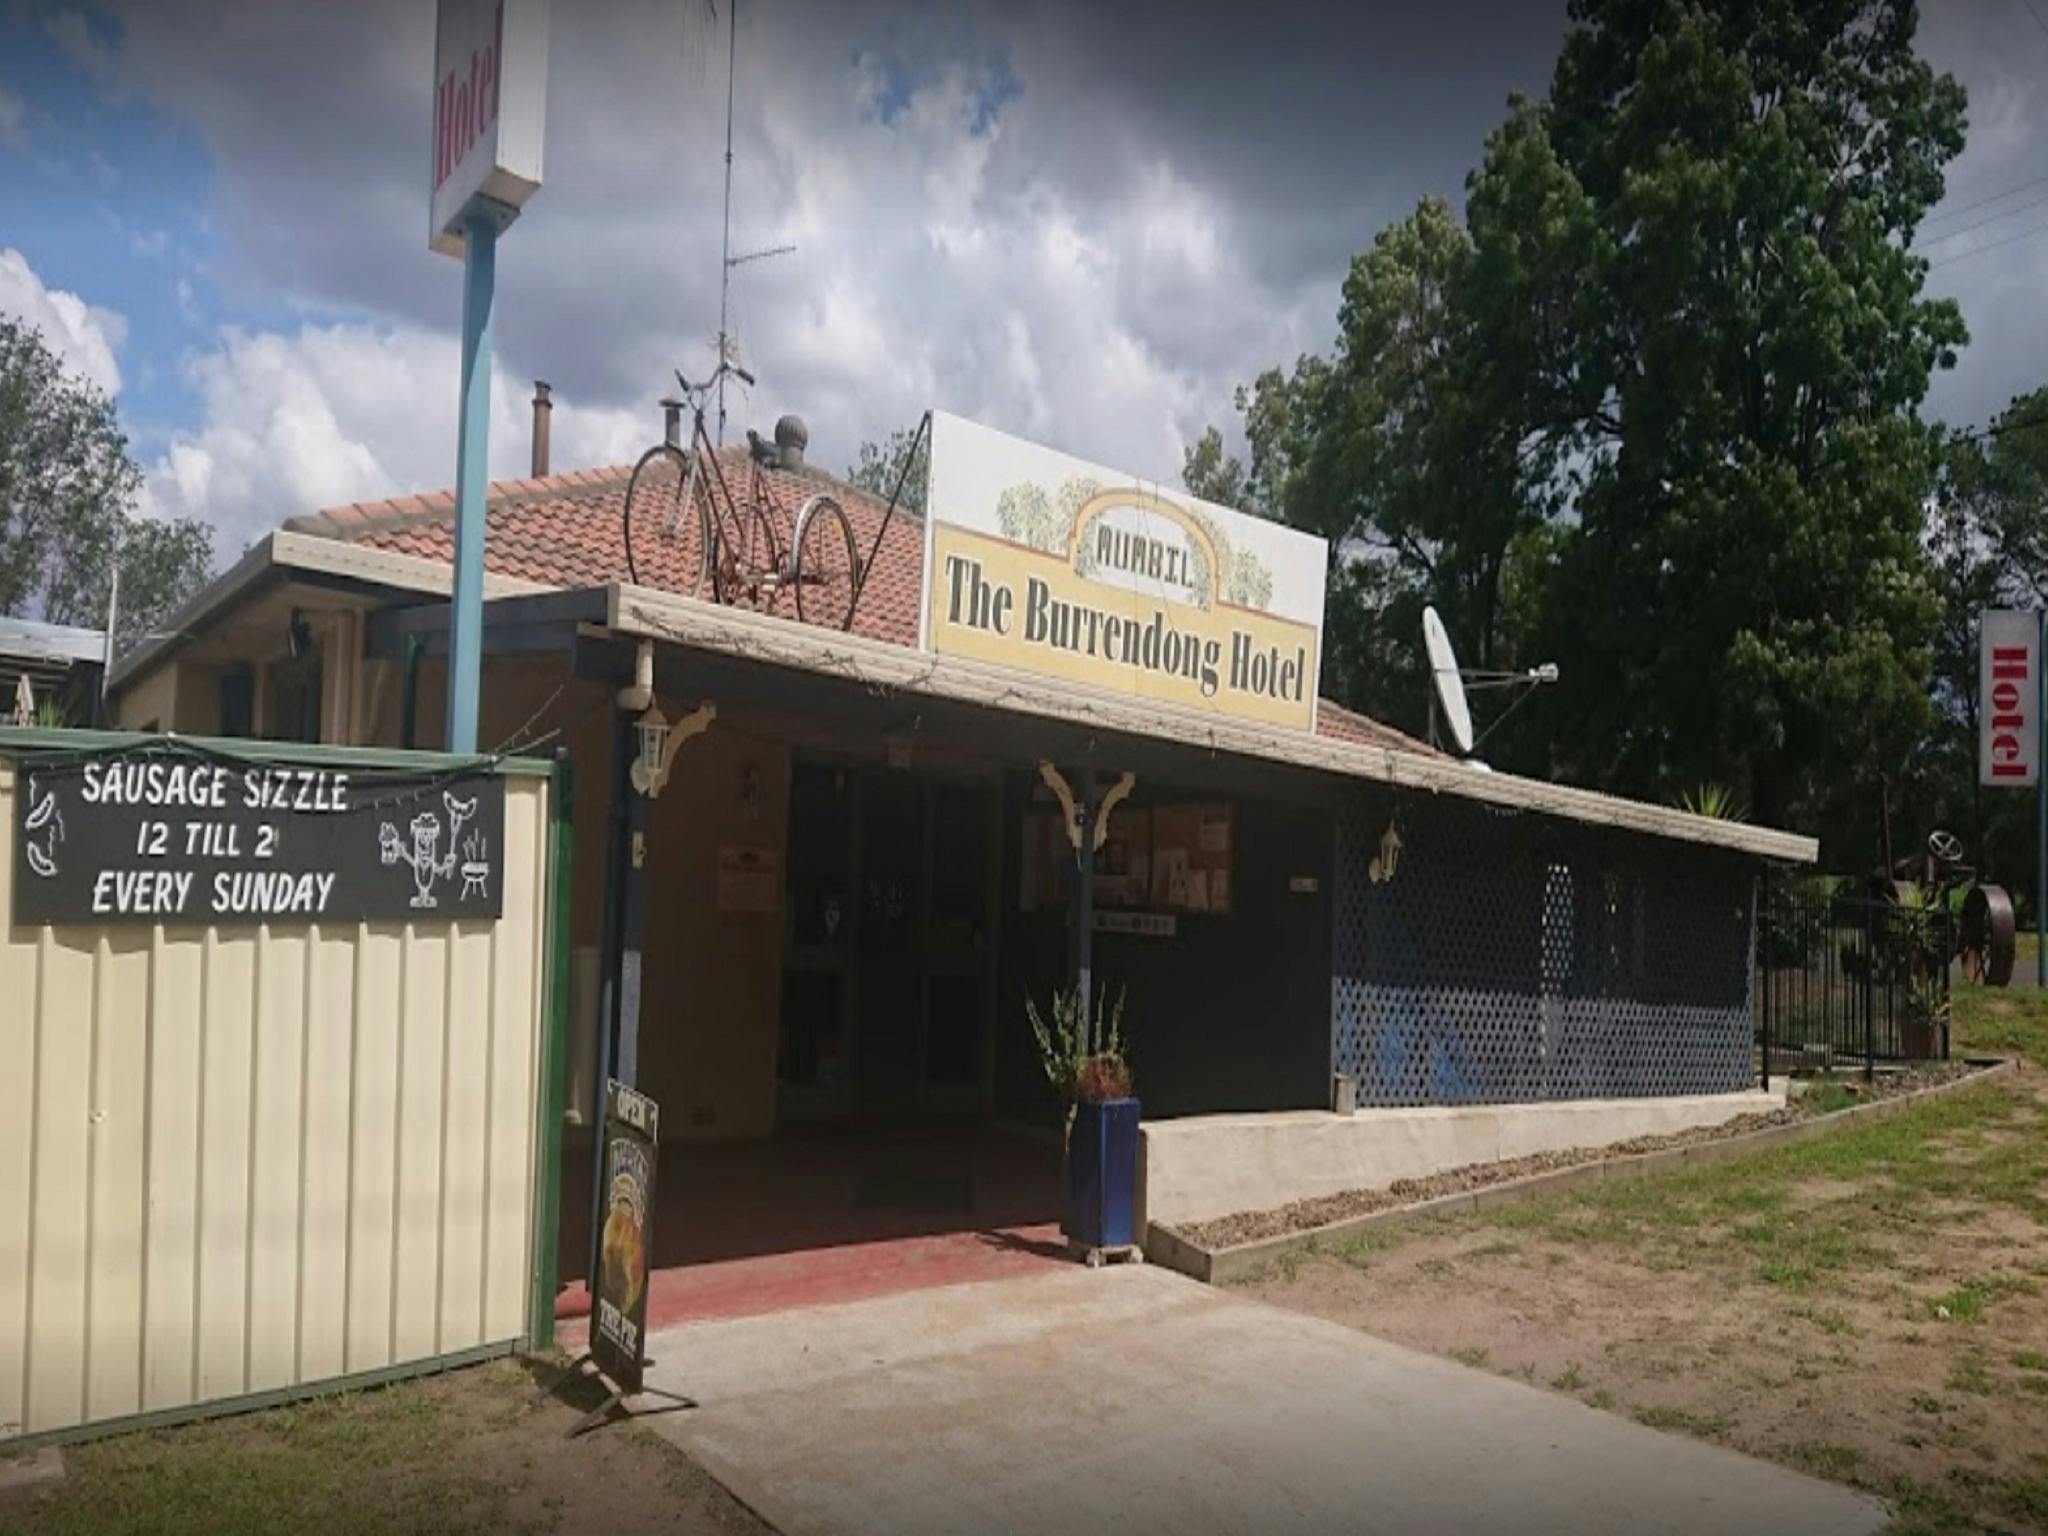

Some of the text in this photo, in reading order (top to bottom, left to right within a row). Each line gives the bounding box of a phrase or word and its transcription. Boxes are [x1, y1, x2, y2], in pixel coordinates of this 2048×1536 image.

[946, 556, 1306, 703] The Burrendong Hotel
[1993, 648, 2027, 776] Hotel
[81, 762, 350, 811] SAUSAGE SIZZLE
[136, 821, 169, 857] 12
[184, 824, 241, 856] TILL
[92, 872, 335, 912] EVERY SUNDAY
